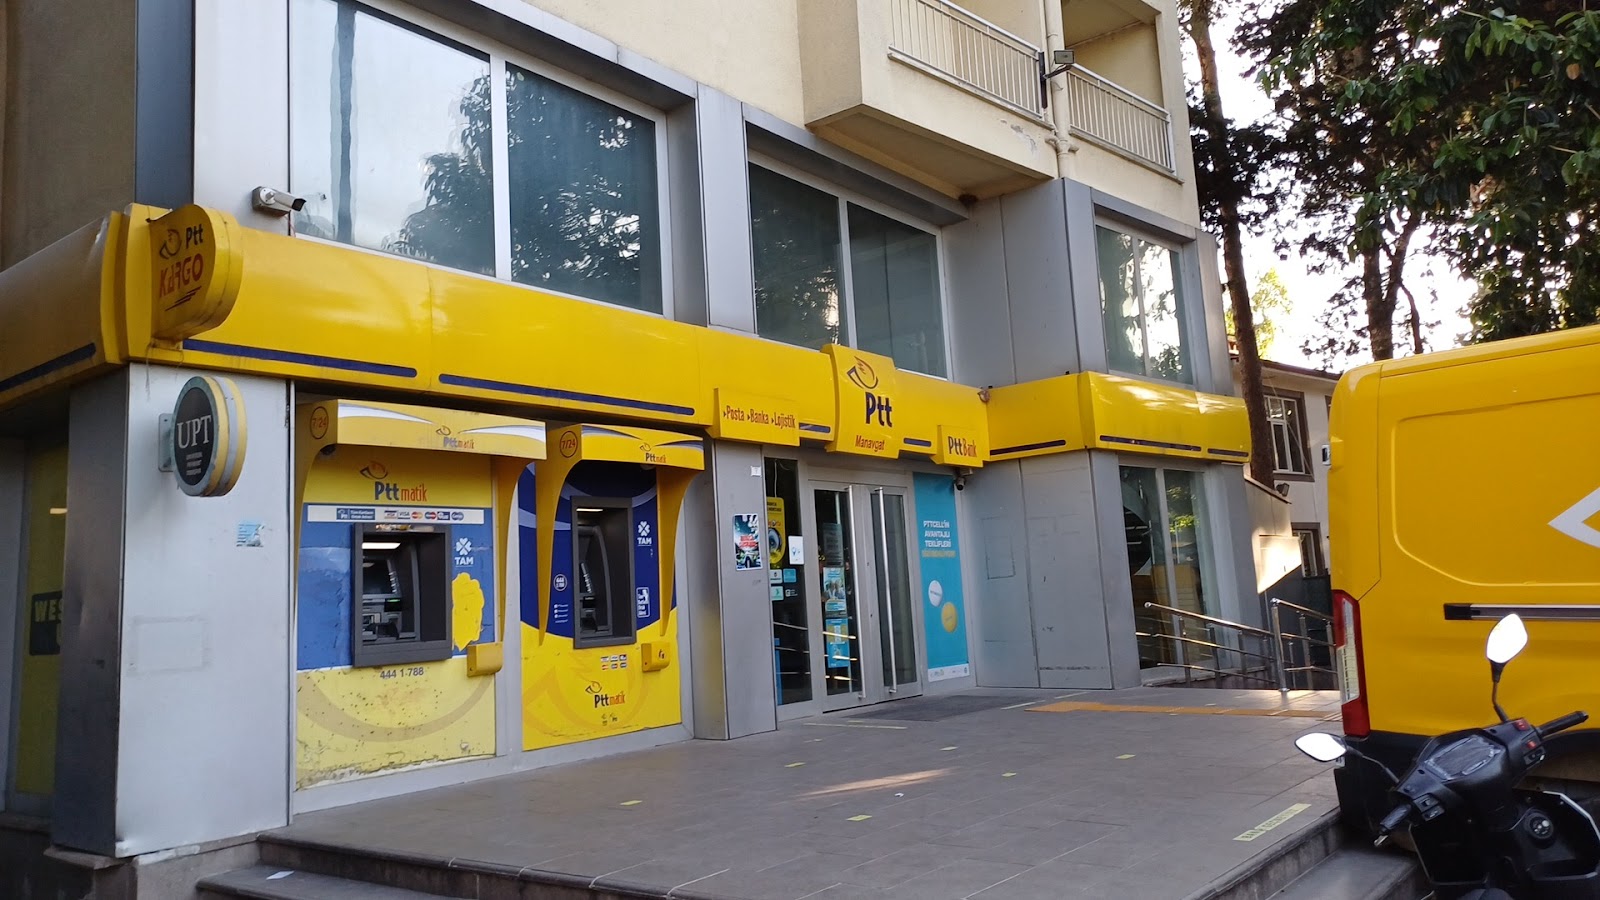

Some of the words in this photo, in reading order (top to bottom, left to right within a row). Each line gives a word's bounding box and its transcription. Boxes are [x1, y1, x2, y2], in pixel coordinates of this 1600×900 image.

[186, 223, 204, 249] Ptt
[726, 405, 745, 421] Posta
[750, 408, 769, 425] Banka
[774, 411, 796, 430] Lojistik
[865, 391, 893, 428] Ptt
[177, 414, 212, 449] UPT
[561, 438, 576, 450] 7/24
[855, 434, 885, 453] Manavgat
[637, 537, 652, 545] TAM
[454, 557, 474, 566] TAM
[380, 669, 397, 679] 444
[400, 668, 404, 677] 1
[407, 666, 424, 677] 788
